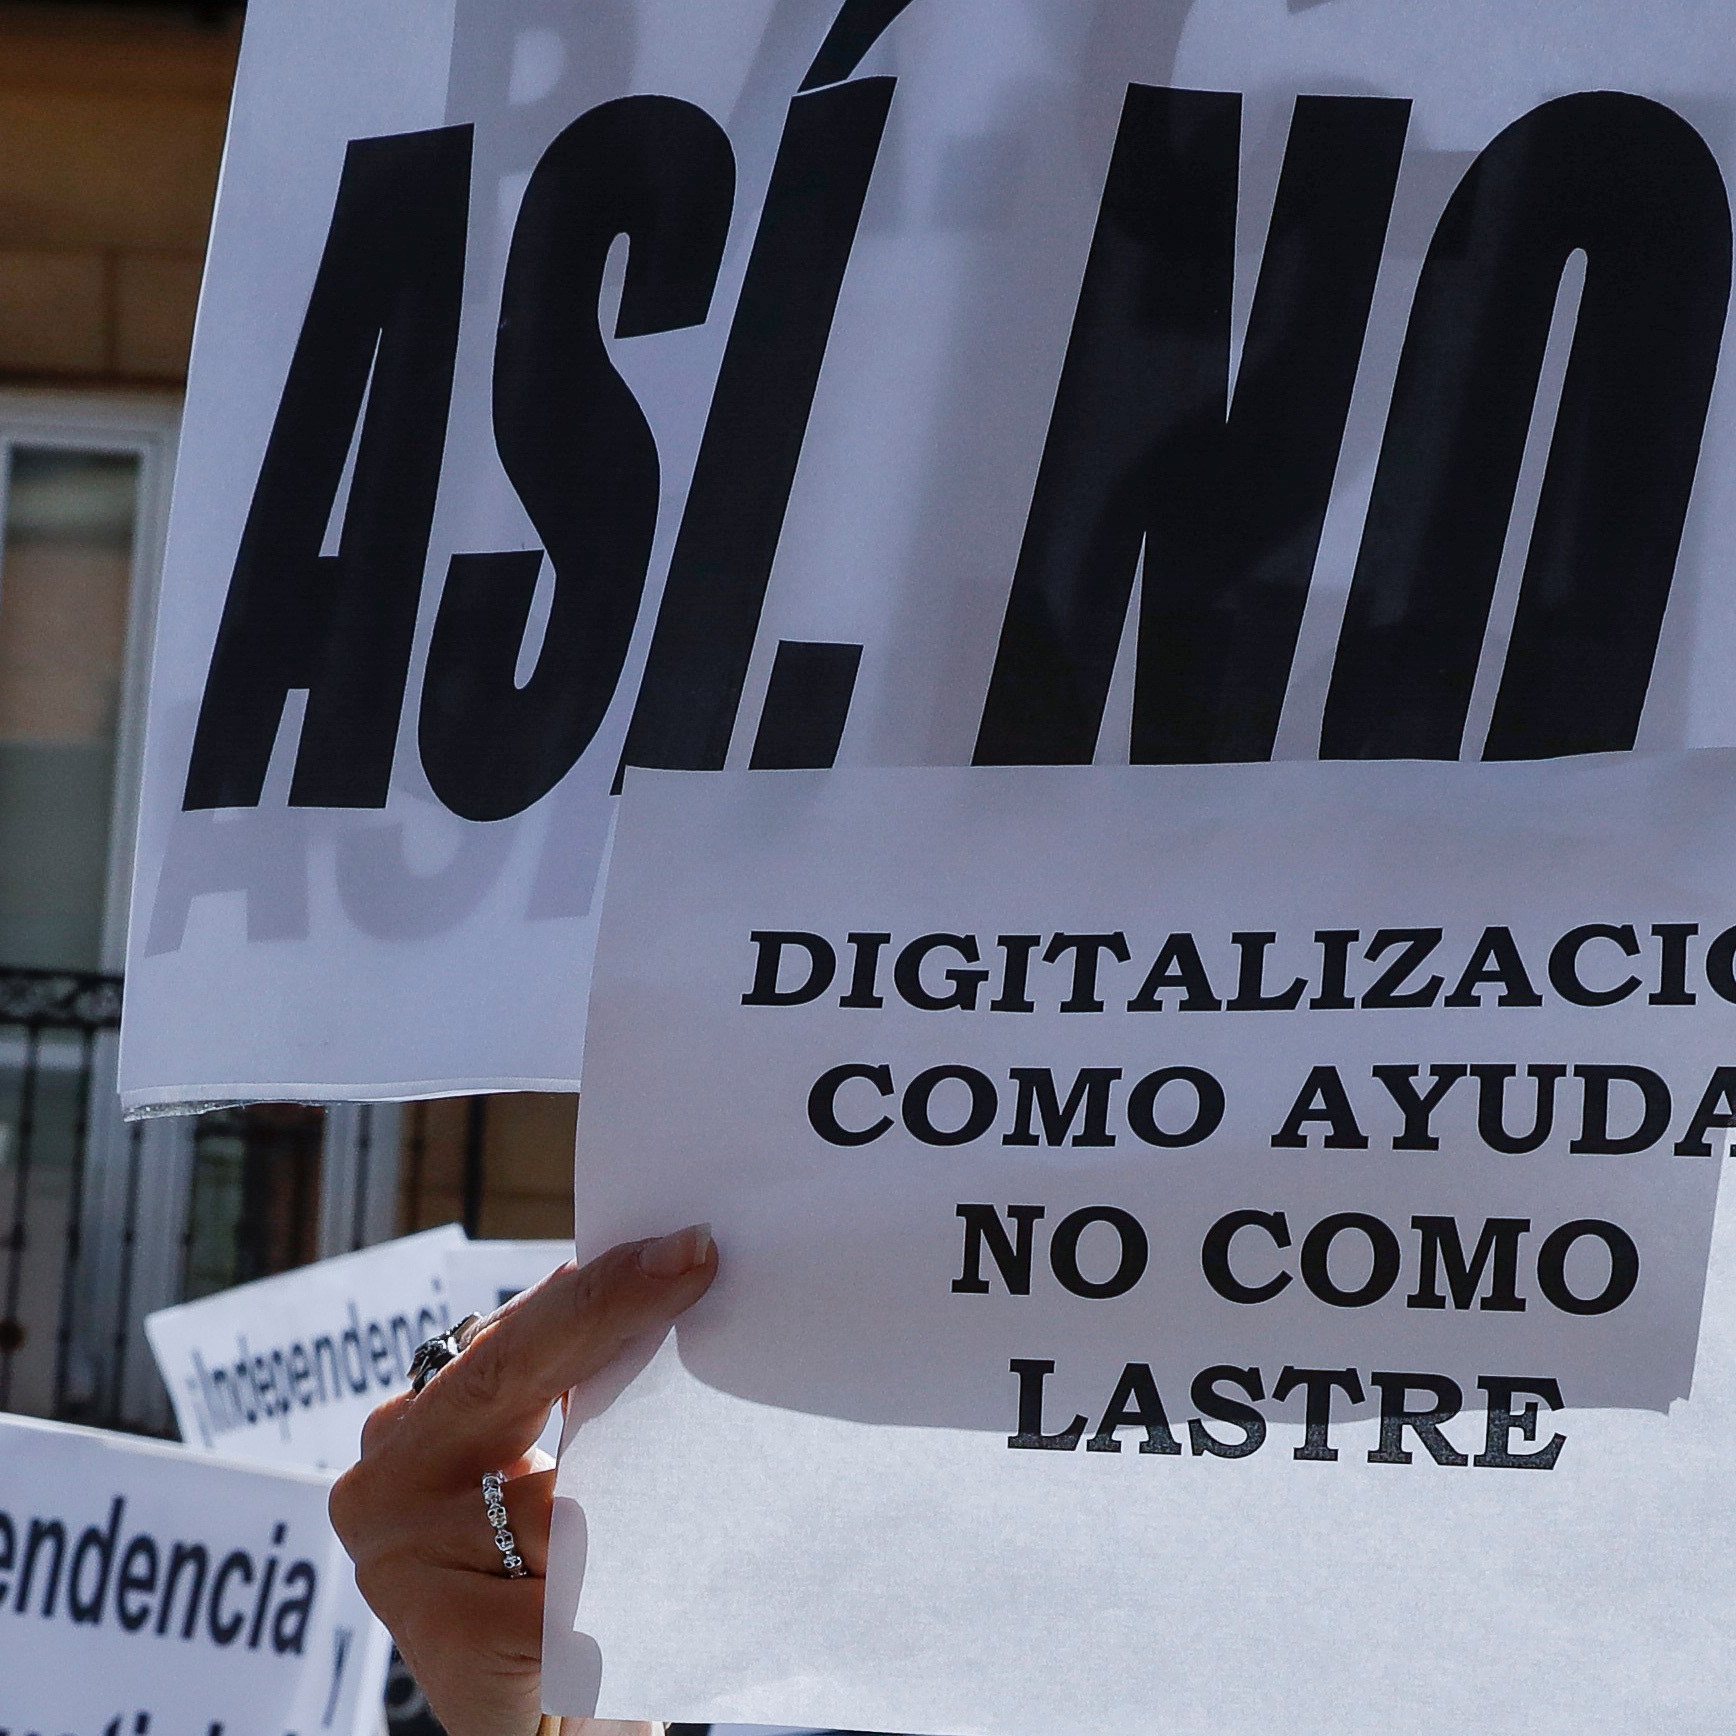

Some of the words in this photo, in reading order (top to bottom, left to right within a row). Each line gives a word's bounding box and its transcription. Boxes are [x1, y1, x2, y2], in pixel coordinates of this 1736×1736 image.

[971, 82, 1733, 766] NO
[808, 1064, 1225, 1148] COMO
[951, 1204, 1148, 1299] NO
[1202, 1210, 1639, 1315] COMO
[1008, 1359, 1566, 1470] LASTRE
